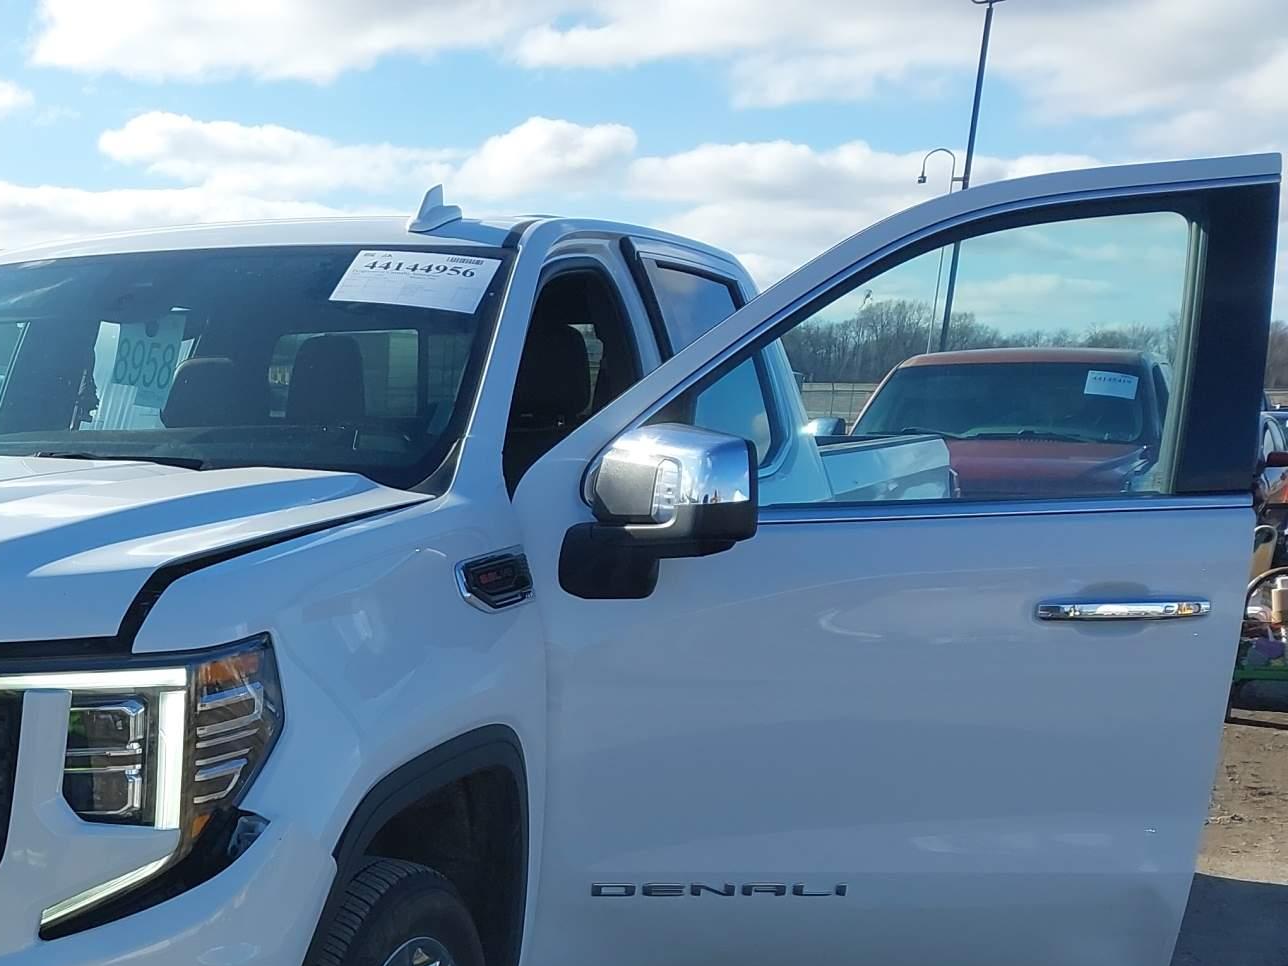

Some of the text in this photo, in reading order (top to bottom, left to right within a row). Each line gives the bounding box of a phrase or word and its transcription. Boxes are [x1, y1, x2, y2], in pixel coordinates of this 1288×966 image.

[364, 260, 475, 278] 44144956
[113, 337, 176, 389] 8958
[591, 881, 849, 897] DENALI
